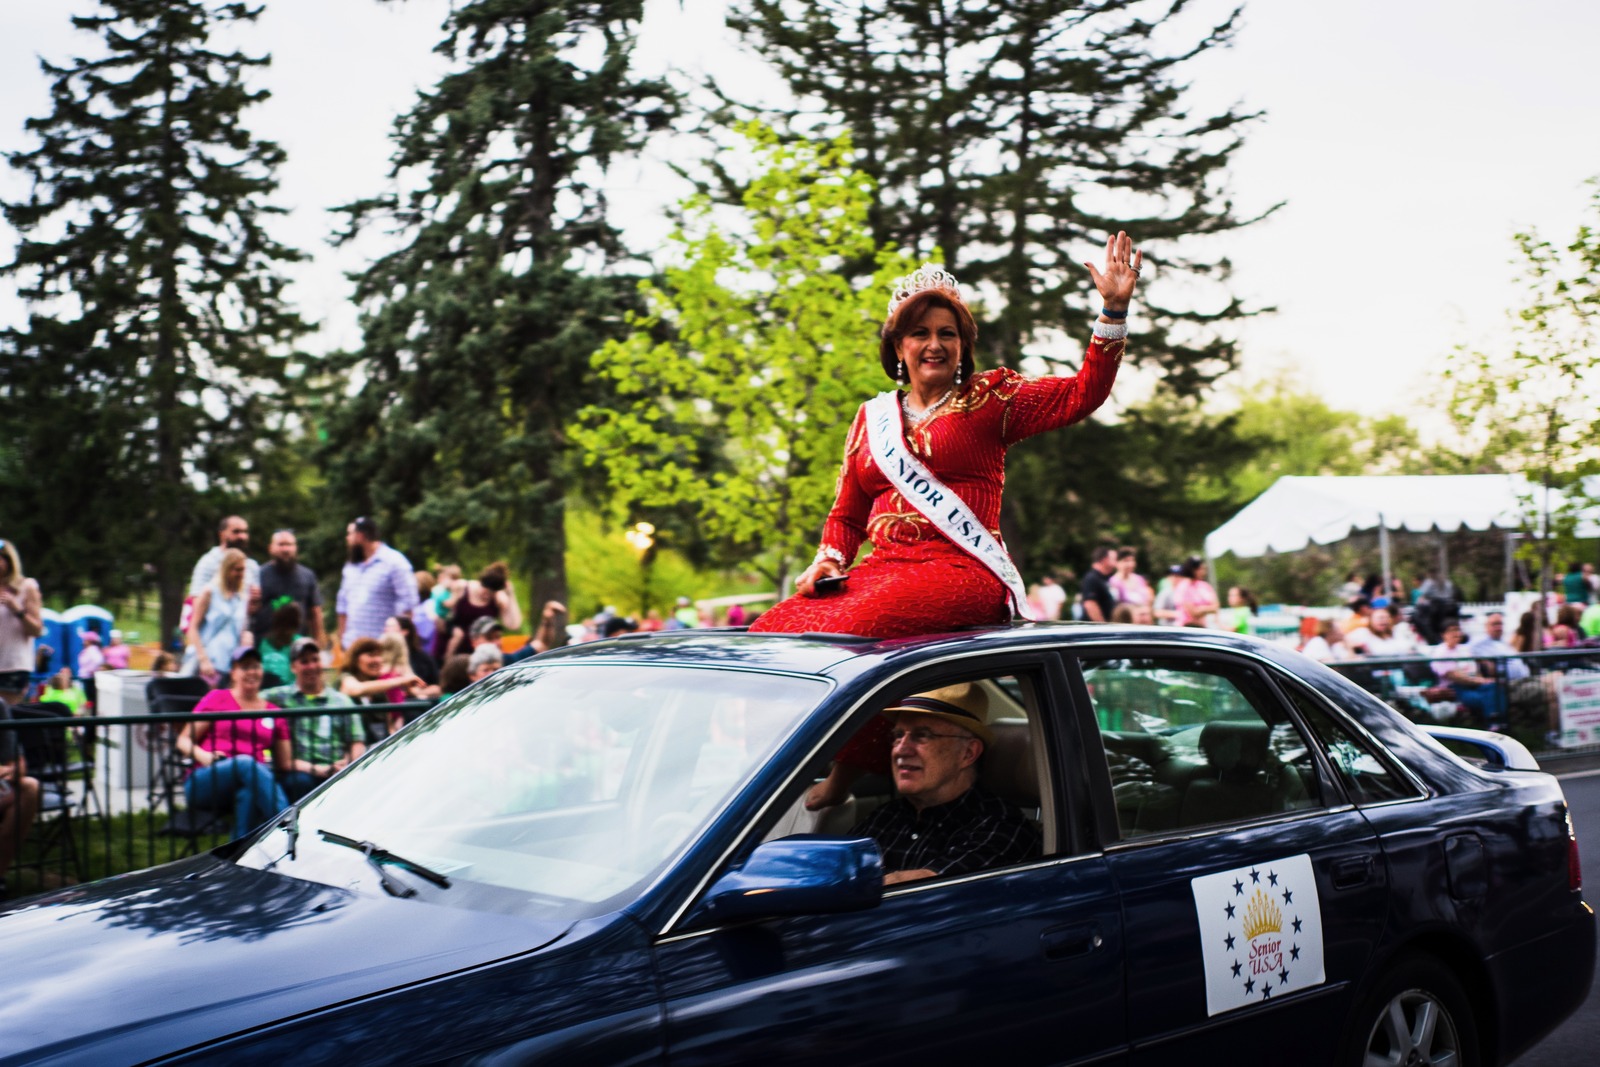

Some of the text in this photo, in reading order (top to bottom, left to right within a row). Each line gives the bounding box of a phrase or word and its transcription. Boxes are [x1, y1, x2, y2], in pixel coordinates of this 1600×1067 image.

[947, 506, 985, 548] USA
[1249, 937, 1282, 959] Senior
[1249, 952, 1283, 976] USA
